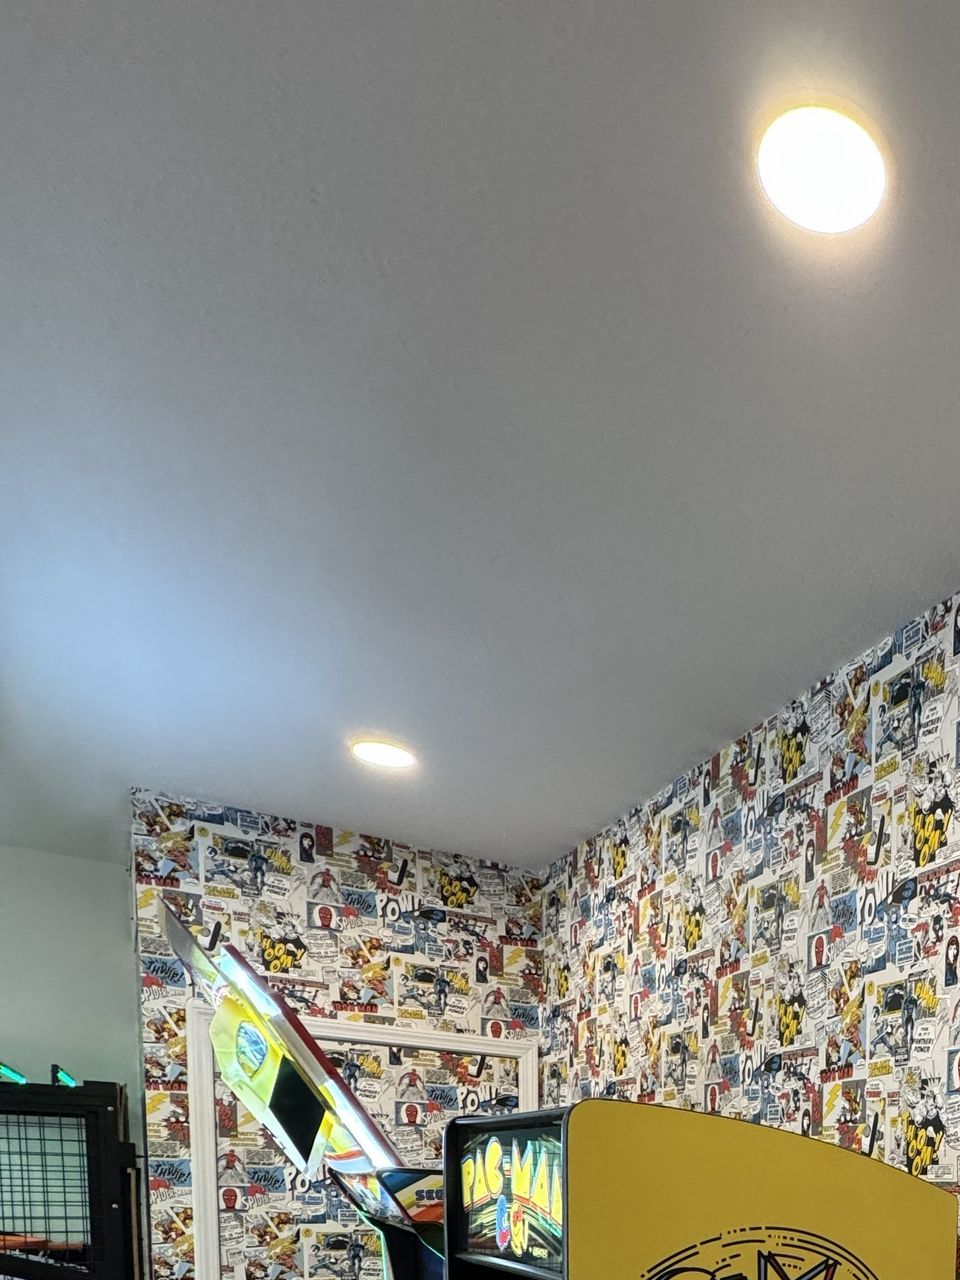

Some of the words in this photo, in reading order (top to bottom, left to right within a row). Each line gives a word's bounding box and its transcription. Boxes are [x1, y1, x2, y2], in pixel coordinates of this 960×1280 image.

[375, 893, 423, 923] POW!
[457, 1086, 498, 1110] POW!
[415, 1189, 444, 1201] SEG
